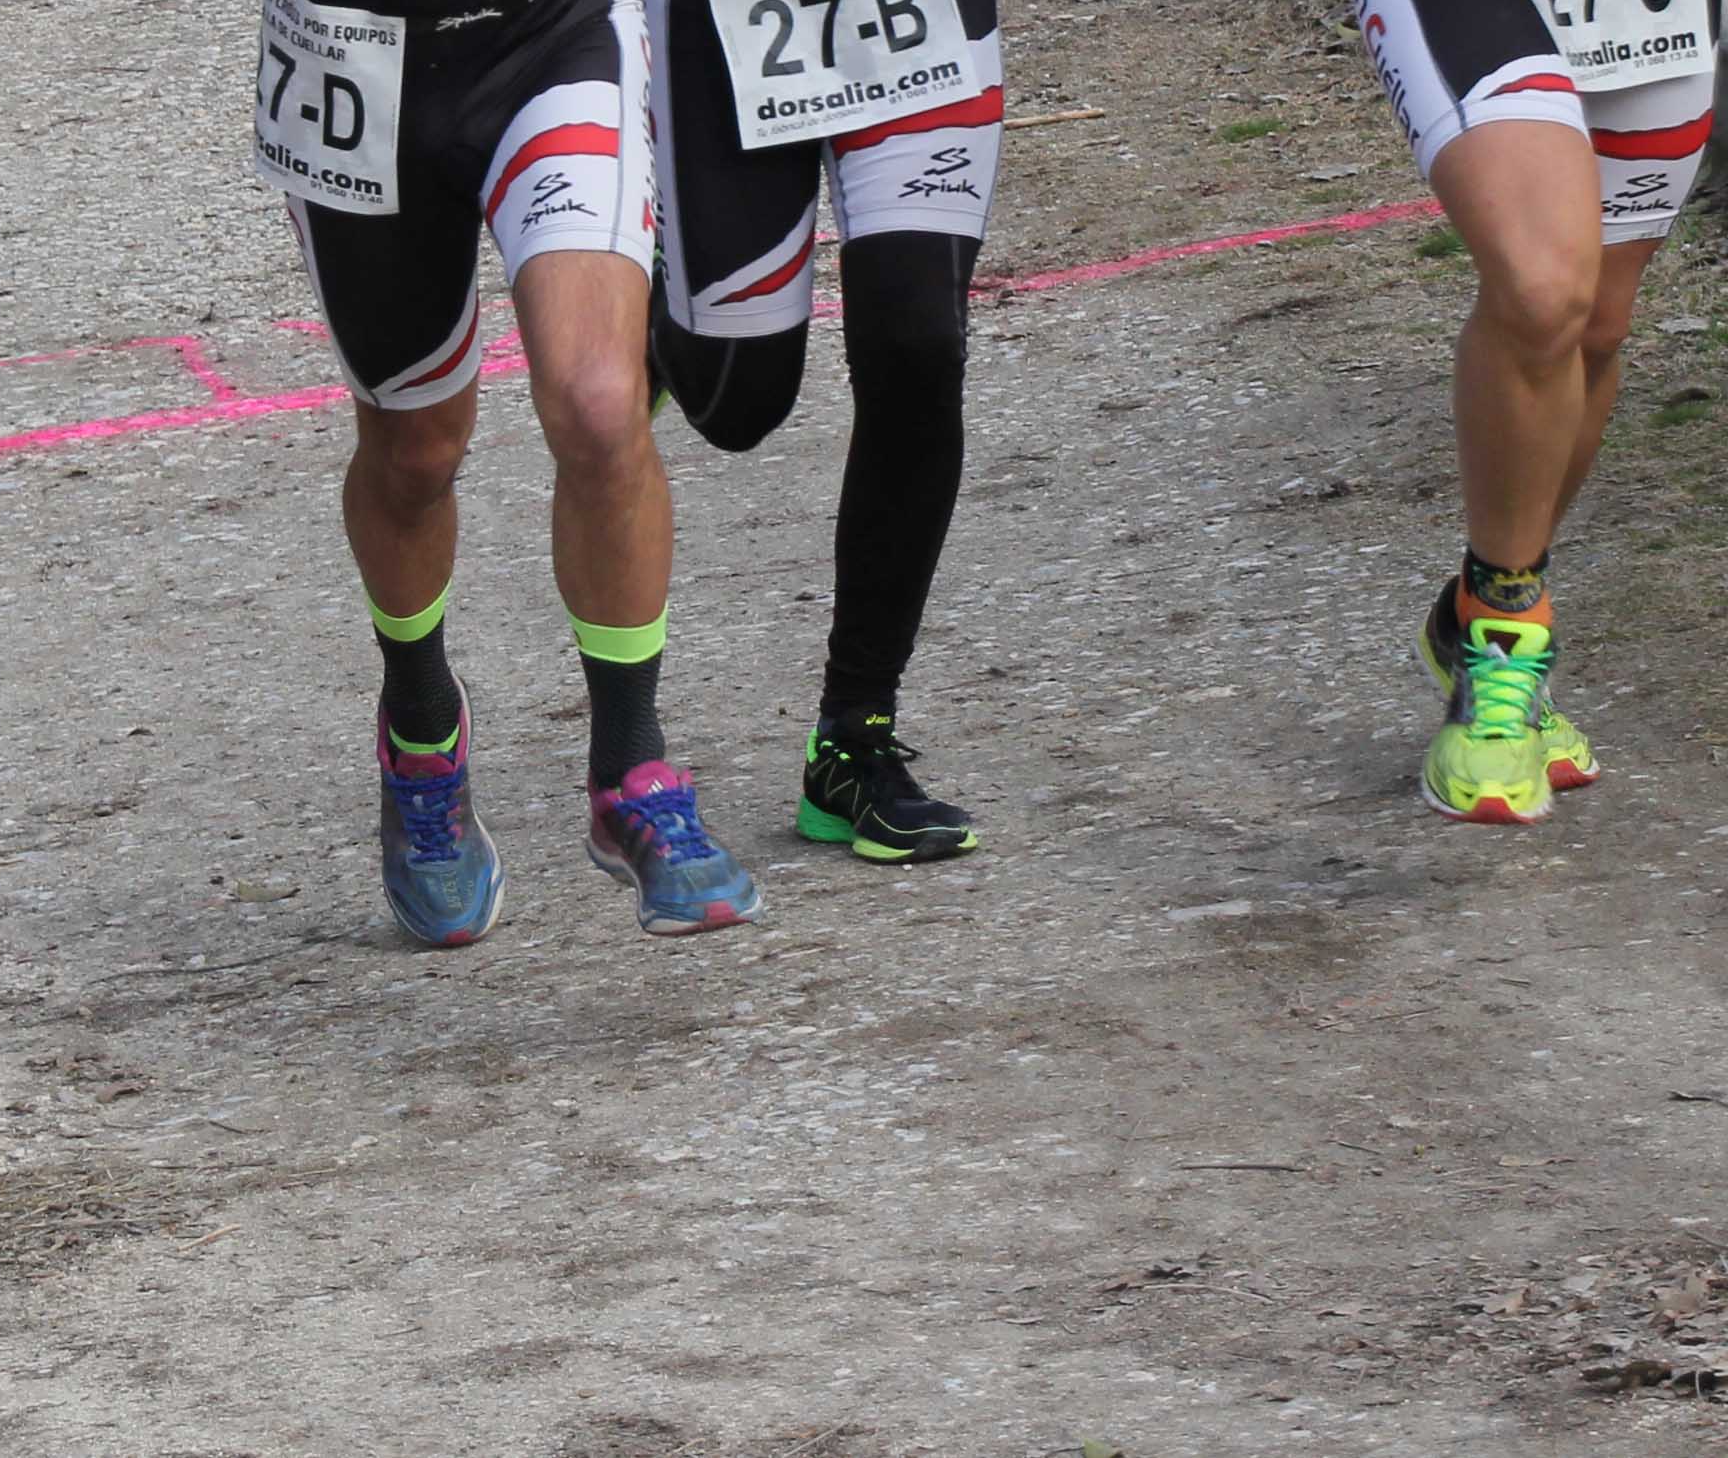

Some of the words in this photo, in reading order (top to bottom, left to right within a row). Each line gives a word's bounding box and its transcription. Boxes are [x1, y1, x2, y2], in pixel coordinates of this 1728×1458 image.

[290, 32, 346, 63] CUELLAR
[303, 17, 329, 38] POR
[334, 24, 398, 47] EQUIPOS
[257, 41, 365, 152] 7-D
[757, 60, 961, 121] dorsalia.com
[258, 135, 384, 197] alia.com
[897, 178, 982, 201] Spiuk
